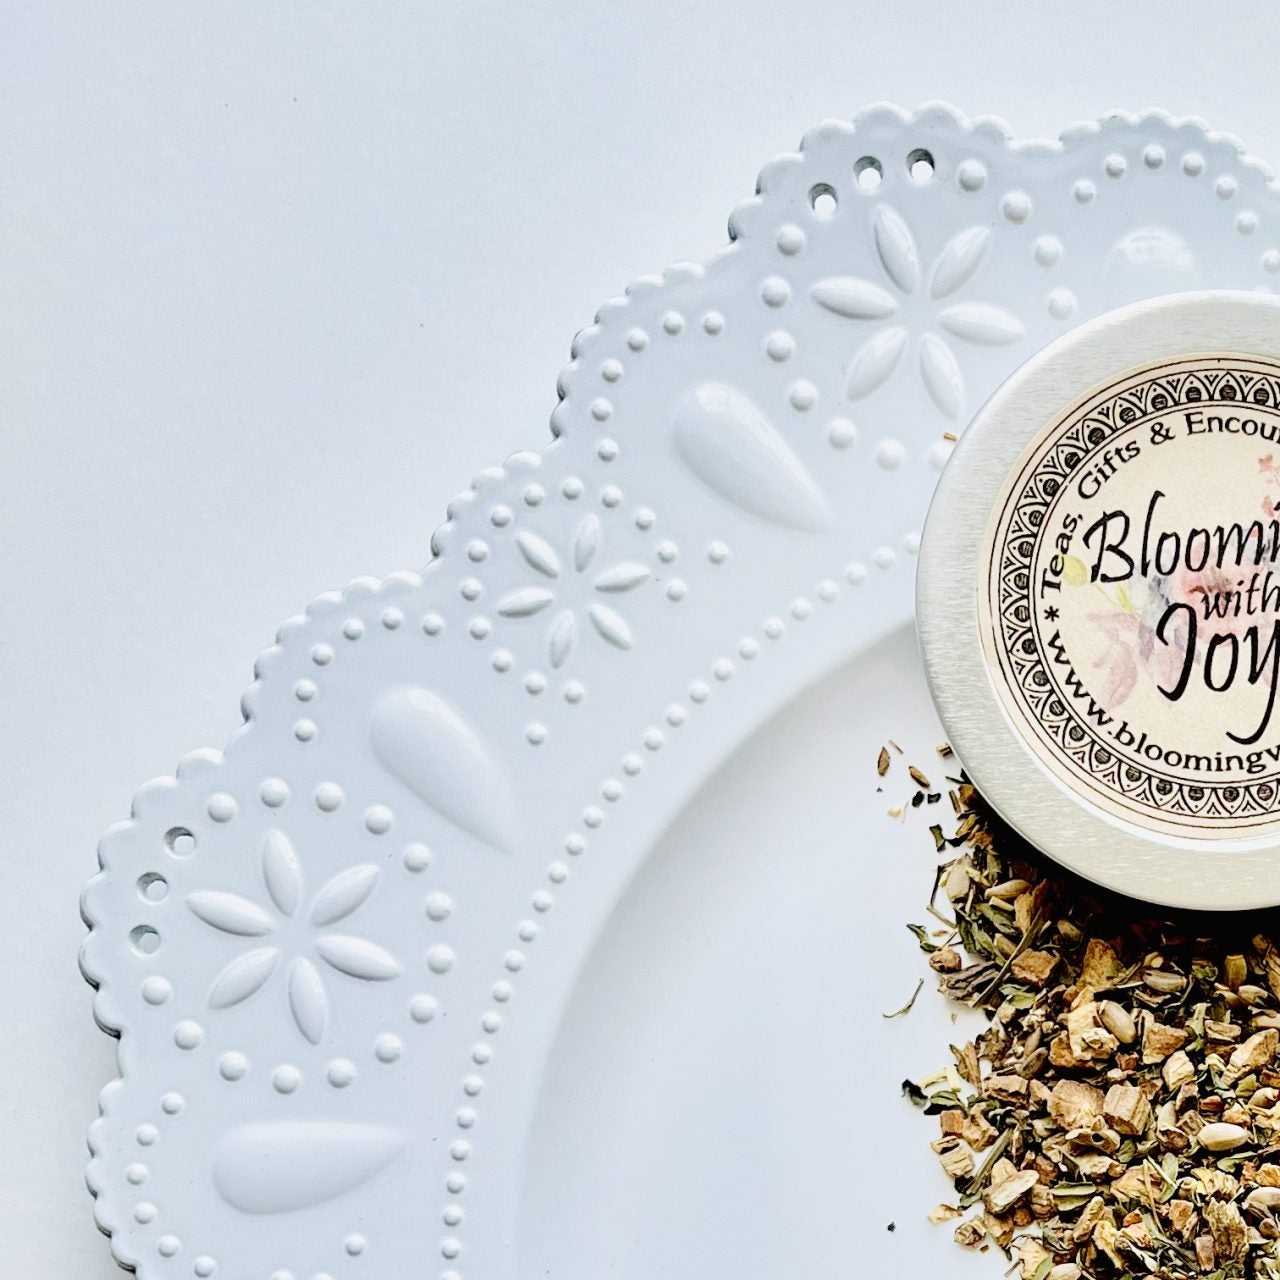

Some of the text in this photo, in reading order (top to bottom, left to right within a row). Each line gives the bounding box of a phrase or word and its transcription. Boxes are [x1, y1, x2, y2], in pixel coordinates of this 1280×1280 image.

[1041, 512, 1084, 599] Teas,
[1077, 440, 1141, 500] Gifts
[1150, 421, 1176, 446] &
